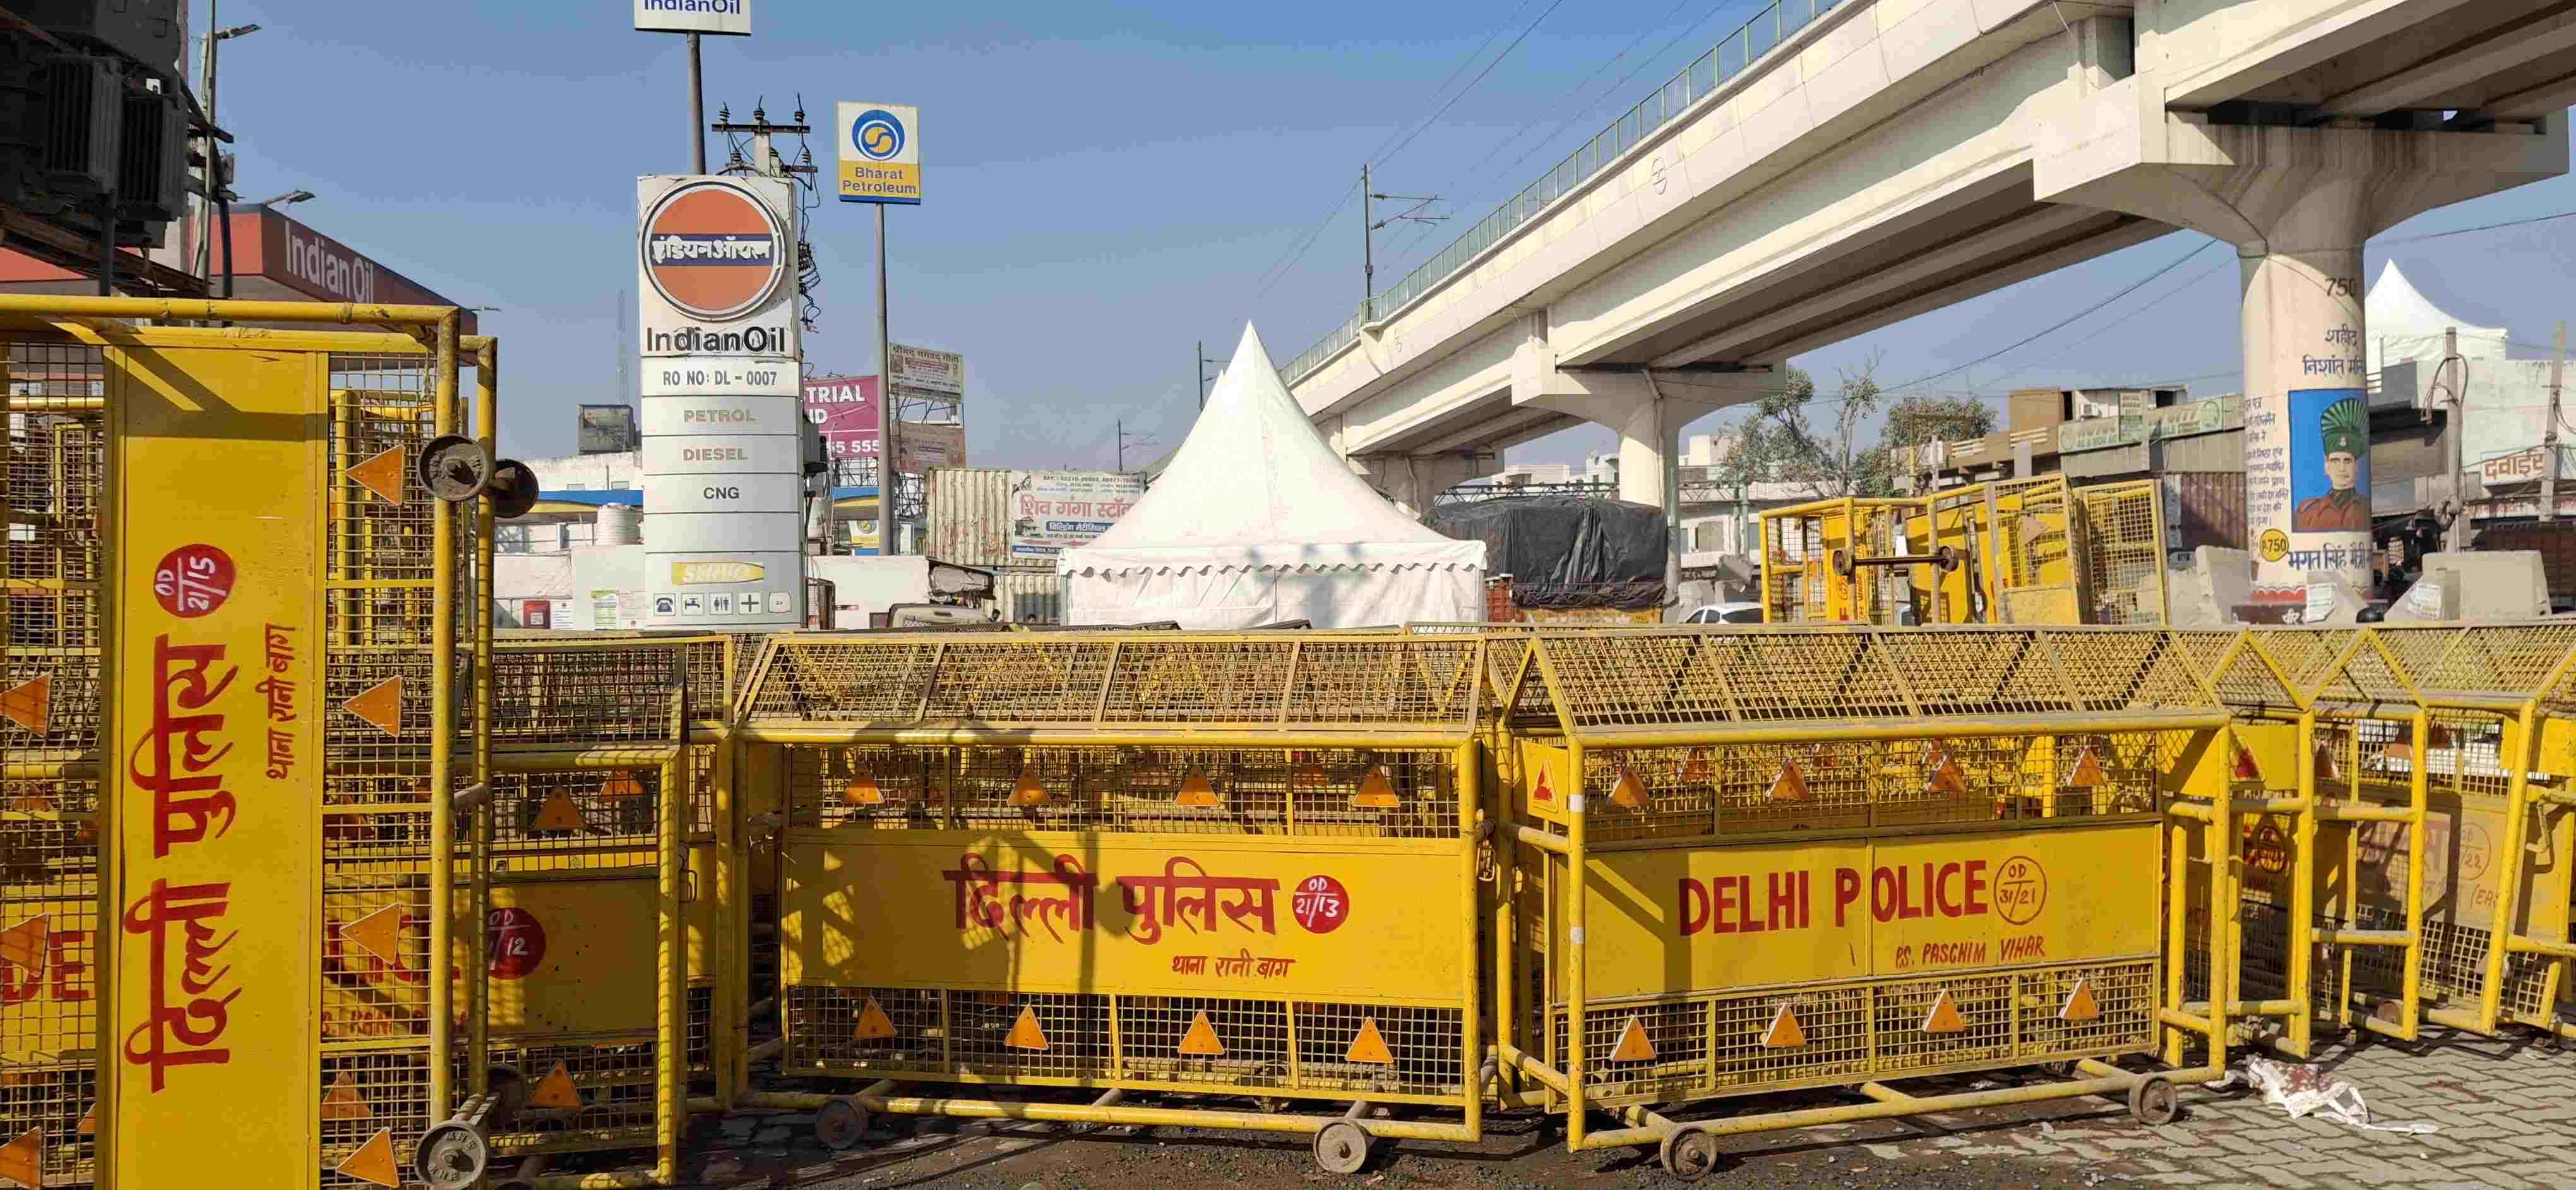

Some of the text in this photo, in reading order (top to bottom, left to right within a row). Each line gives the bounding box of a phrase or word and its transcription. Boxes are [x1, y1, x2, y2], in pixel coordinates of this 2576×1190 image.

[855, 167, 903, 180] Bharat
[842, 180, 917, 195] Petroleum
[647, 326, 786, 352] IndianOil
[663, 371, 681, 386] RO
[715, 371, 731, 386] DL
[746, 371, 777, 386] 0007
[803, 384, 866, 404] TRIAL
[684, 409, 757, 423] PETROL
[683, 447, 748, 462] DIESEL
[703, 486, 739, 500] CNG
[155, 570, 174, 596] OD
[255, 623, 297, 780] थाना रानी बाग
[124, 633, 242, 1093] दिल्ली पुलिस
[2008, 863, 2026, 878] OD
[1308, 878, 1327, 891] OD
[942, 853, 1280, 946] दिल्ली पुलिस
[1678, 860, 1988, 937] DELHI POLICE
[1922, 942, 1986, 965] PASCHIM
[2000, 935, 2046, 961] VIHAR
[1172, 947, 1297, 978] थाना रानी बाग
